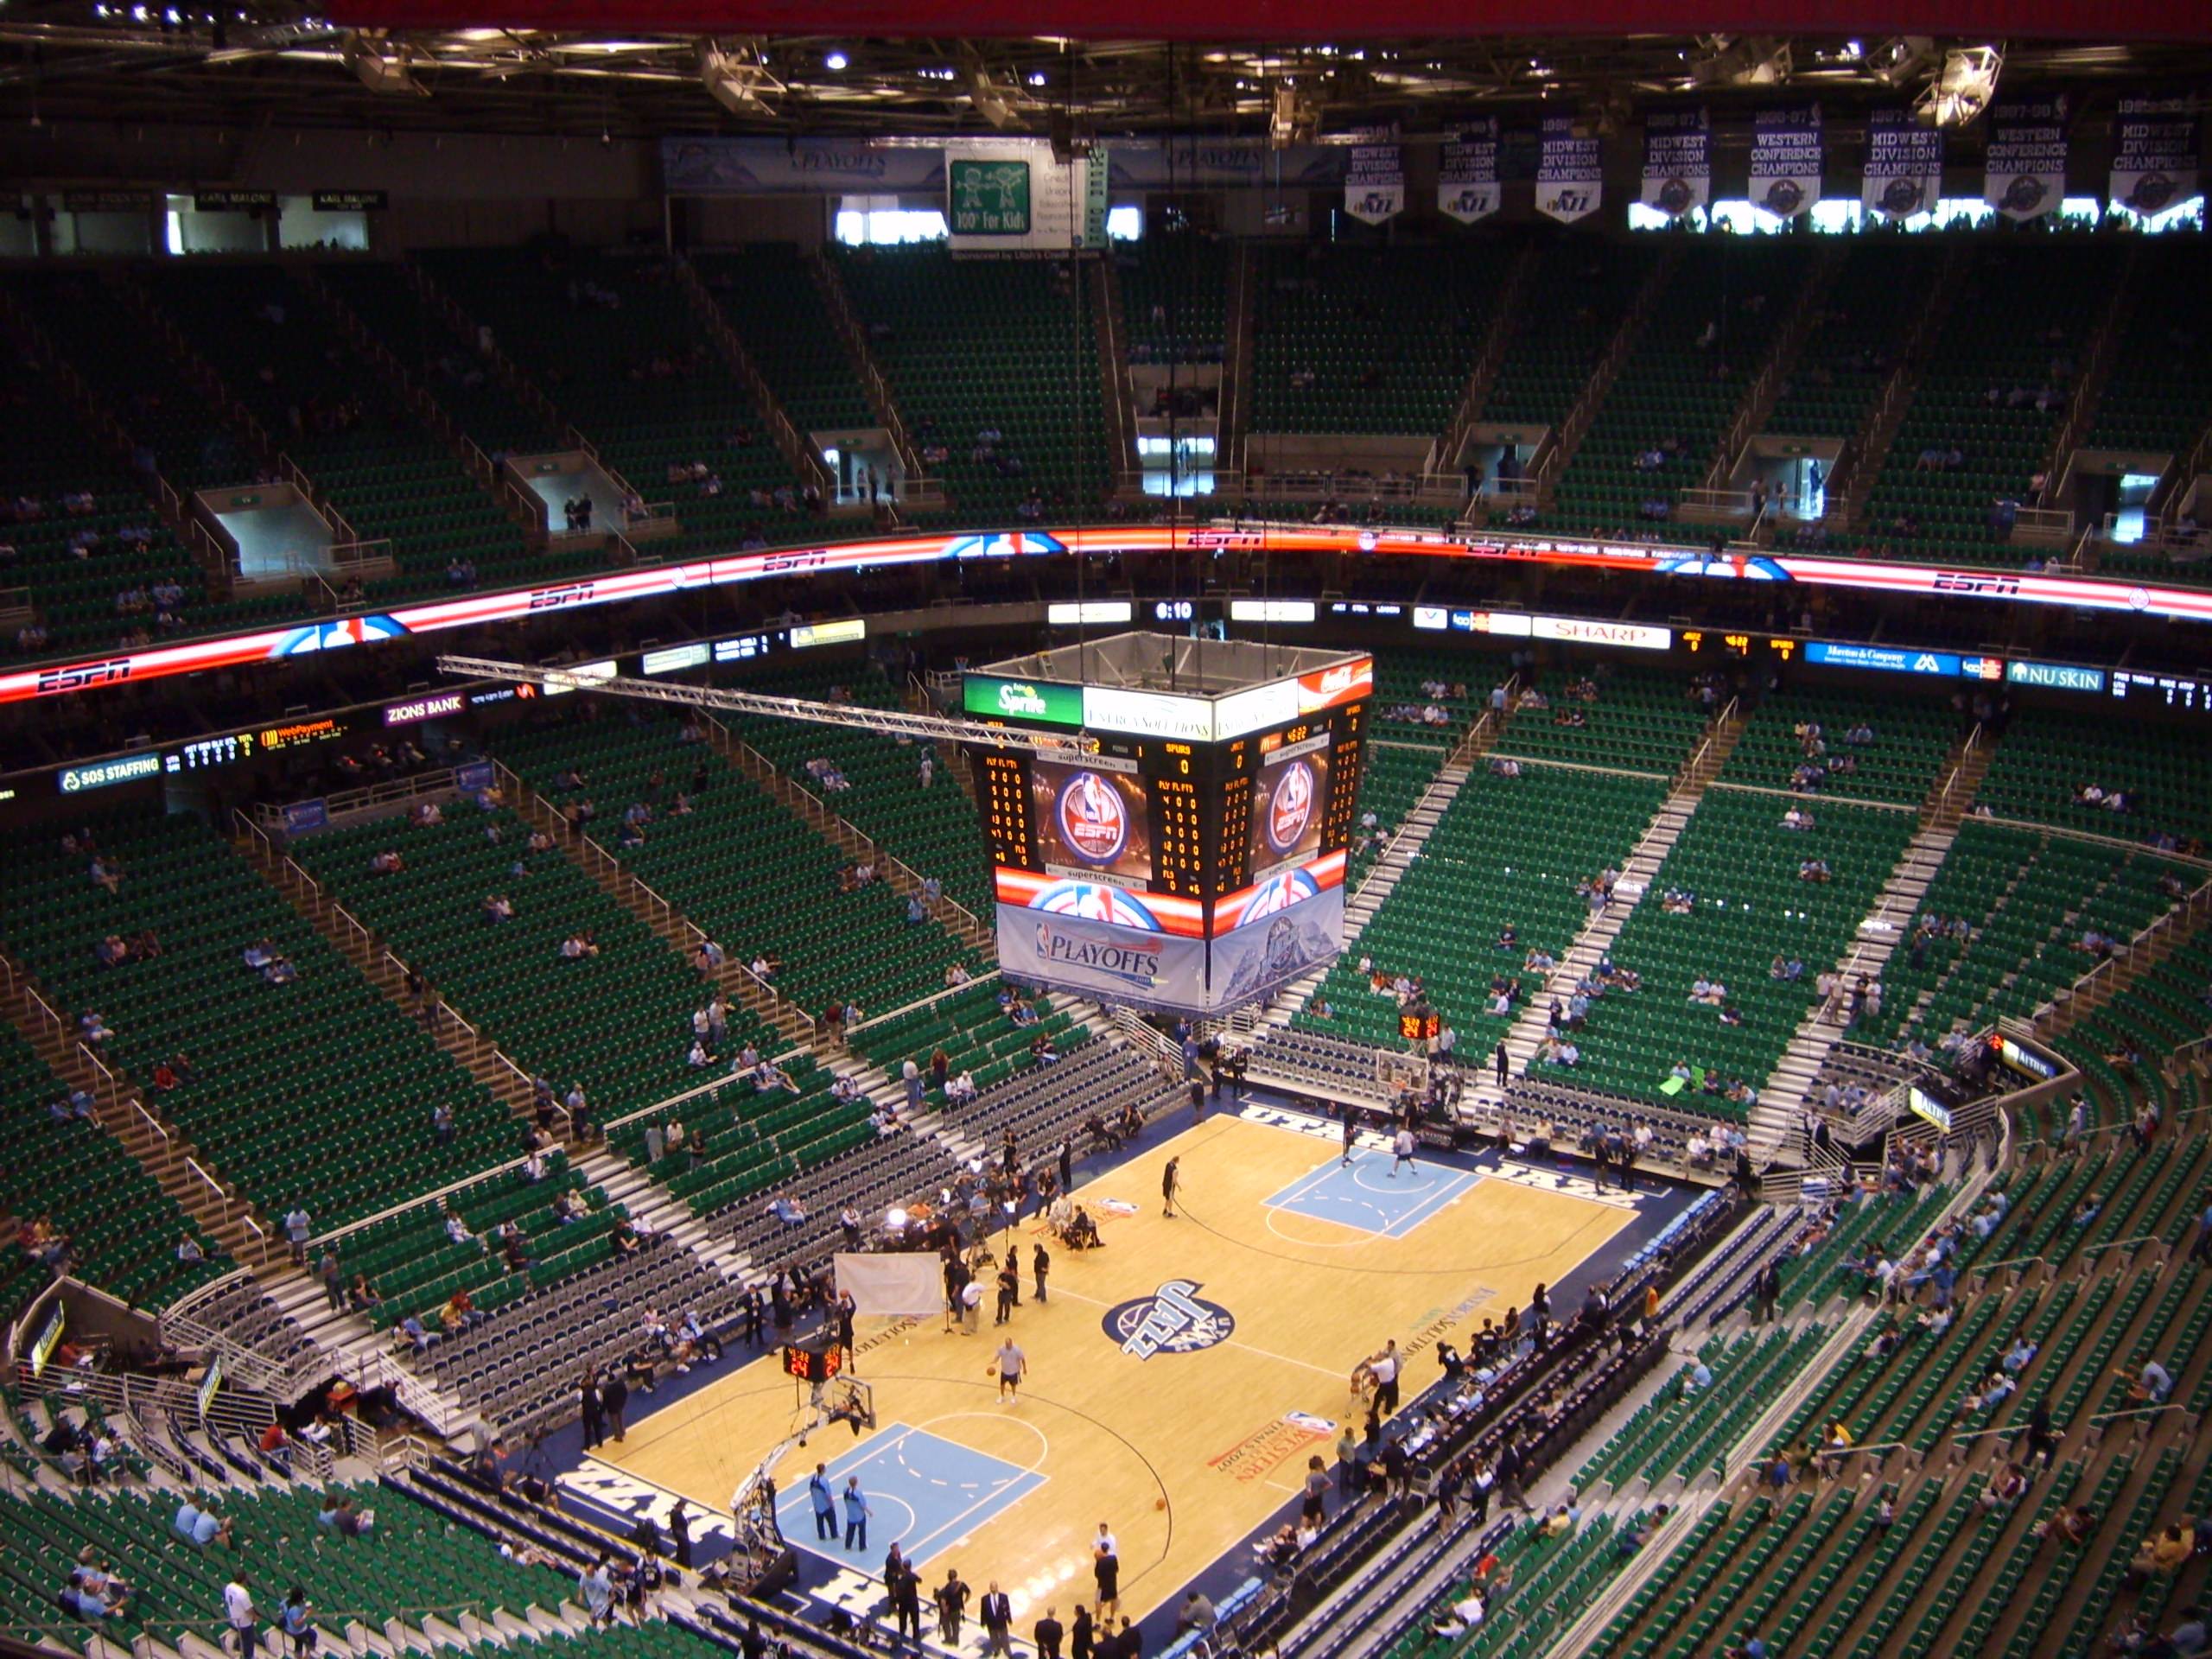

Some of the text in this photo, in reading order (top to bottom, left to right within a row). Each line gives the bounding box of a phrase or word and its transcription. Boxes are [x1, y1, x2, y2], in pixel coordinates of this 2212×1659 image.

[982, 211, 1000, 229] For
[1187, 531, 1264, 546] ESPN
[763, 550, 826, 572] ESPN
[1932, 573, 2020, 594] ESPN
[529, 583, 594, 608] ESPN
[1555, 622, 1646, 642] SHARP
[38, 659, 130, 693] ESPN
[2031, 667, 2099, 690] NU SKIN
[998, 685, 1046, 716] Sprite
[387, 703, 425, 722] ZIONS
[427, 696, 461, 714] BANK
[277, 719, 334, 737] WebPayment
[1166, 743, 1191, 755] SPURS
[1058, 753, 1116, 768] superscreen
[1180, 760, 1188, 774] 0
[1236, 754, 1243, 769] 0
[81, 757, 159, 785] SOS STAFFING
[1014, 773, 1020, 785] 0
[1015, 789, 1021, 799] 0
[1159, 780, 1193, 793] PLY FL PTS
[1017, 804, 1023, 814] 0
[1176, 796, 1182, 807] 0
[1190, 798, 1196, 810] 0
[1019, 818, 1024, 829] 0
[1177, 812, 1183, 823] 0
[1191, 814, 1198, 825] 0
[1276, 808, 1306, 832] ESPN
[1020, 832, 1026, 842] 0
[1074, 822, 1118, 840] ESPN
[1178, 827, 1184, 838] 0
[1192, 829, 1198, 841] 0
[1179, 842, 1185, 854] 0
[1193, 845, 1199, 856] 0
[1020, 855, 1027, 866] 0
[1180, 857, 1186, 869] 0
[1194, 860, 1200, 871] 0
[1067, 871, 1125, 887] superscreen
[1170, 880, 1176, 891] 0
[1051, 935, 1160, 977] PLAYOFFS
[1403, 1027, 1419, 1038] 24
[1426, 1022, 1438, 1038] 24
[1239, 1105, 1398, 1154] UTAH
[1475, 1160, 1645, 1209] JAZZ
[1121, 1281, 1215, 1360] JAZZ
[791, 1361, 808, 1378] 24
[1217, 1420, 1285, 1473] FINALS 2007
[1235, 1429, 1311, 1483] WESTERN
